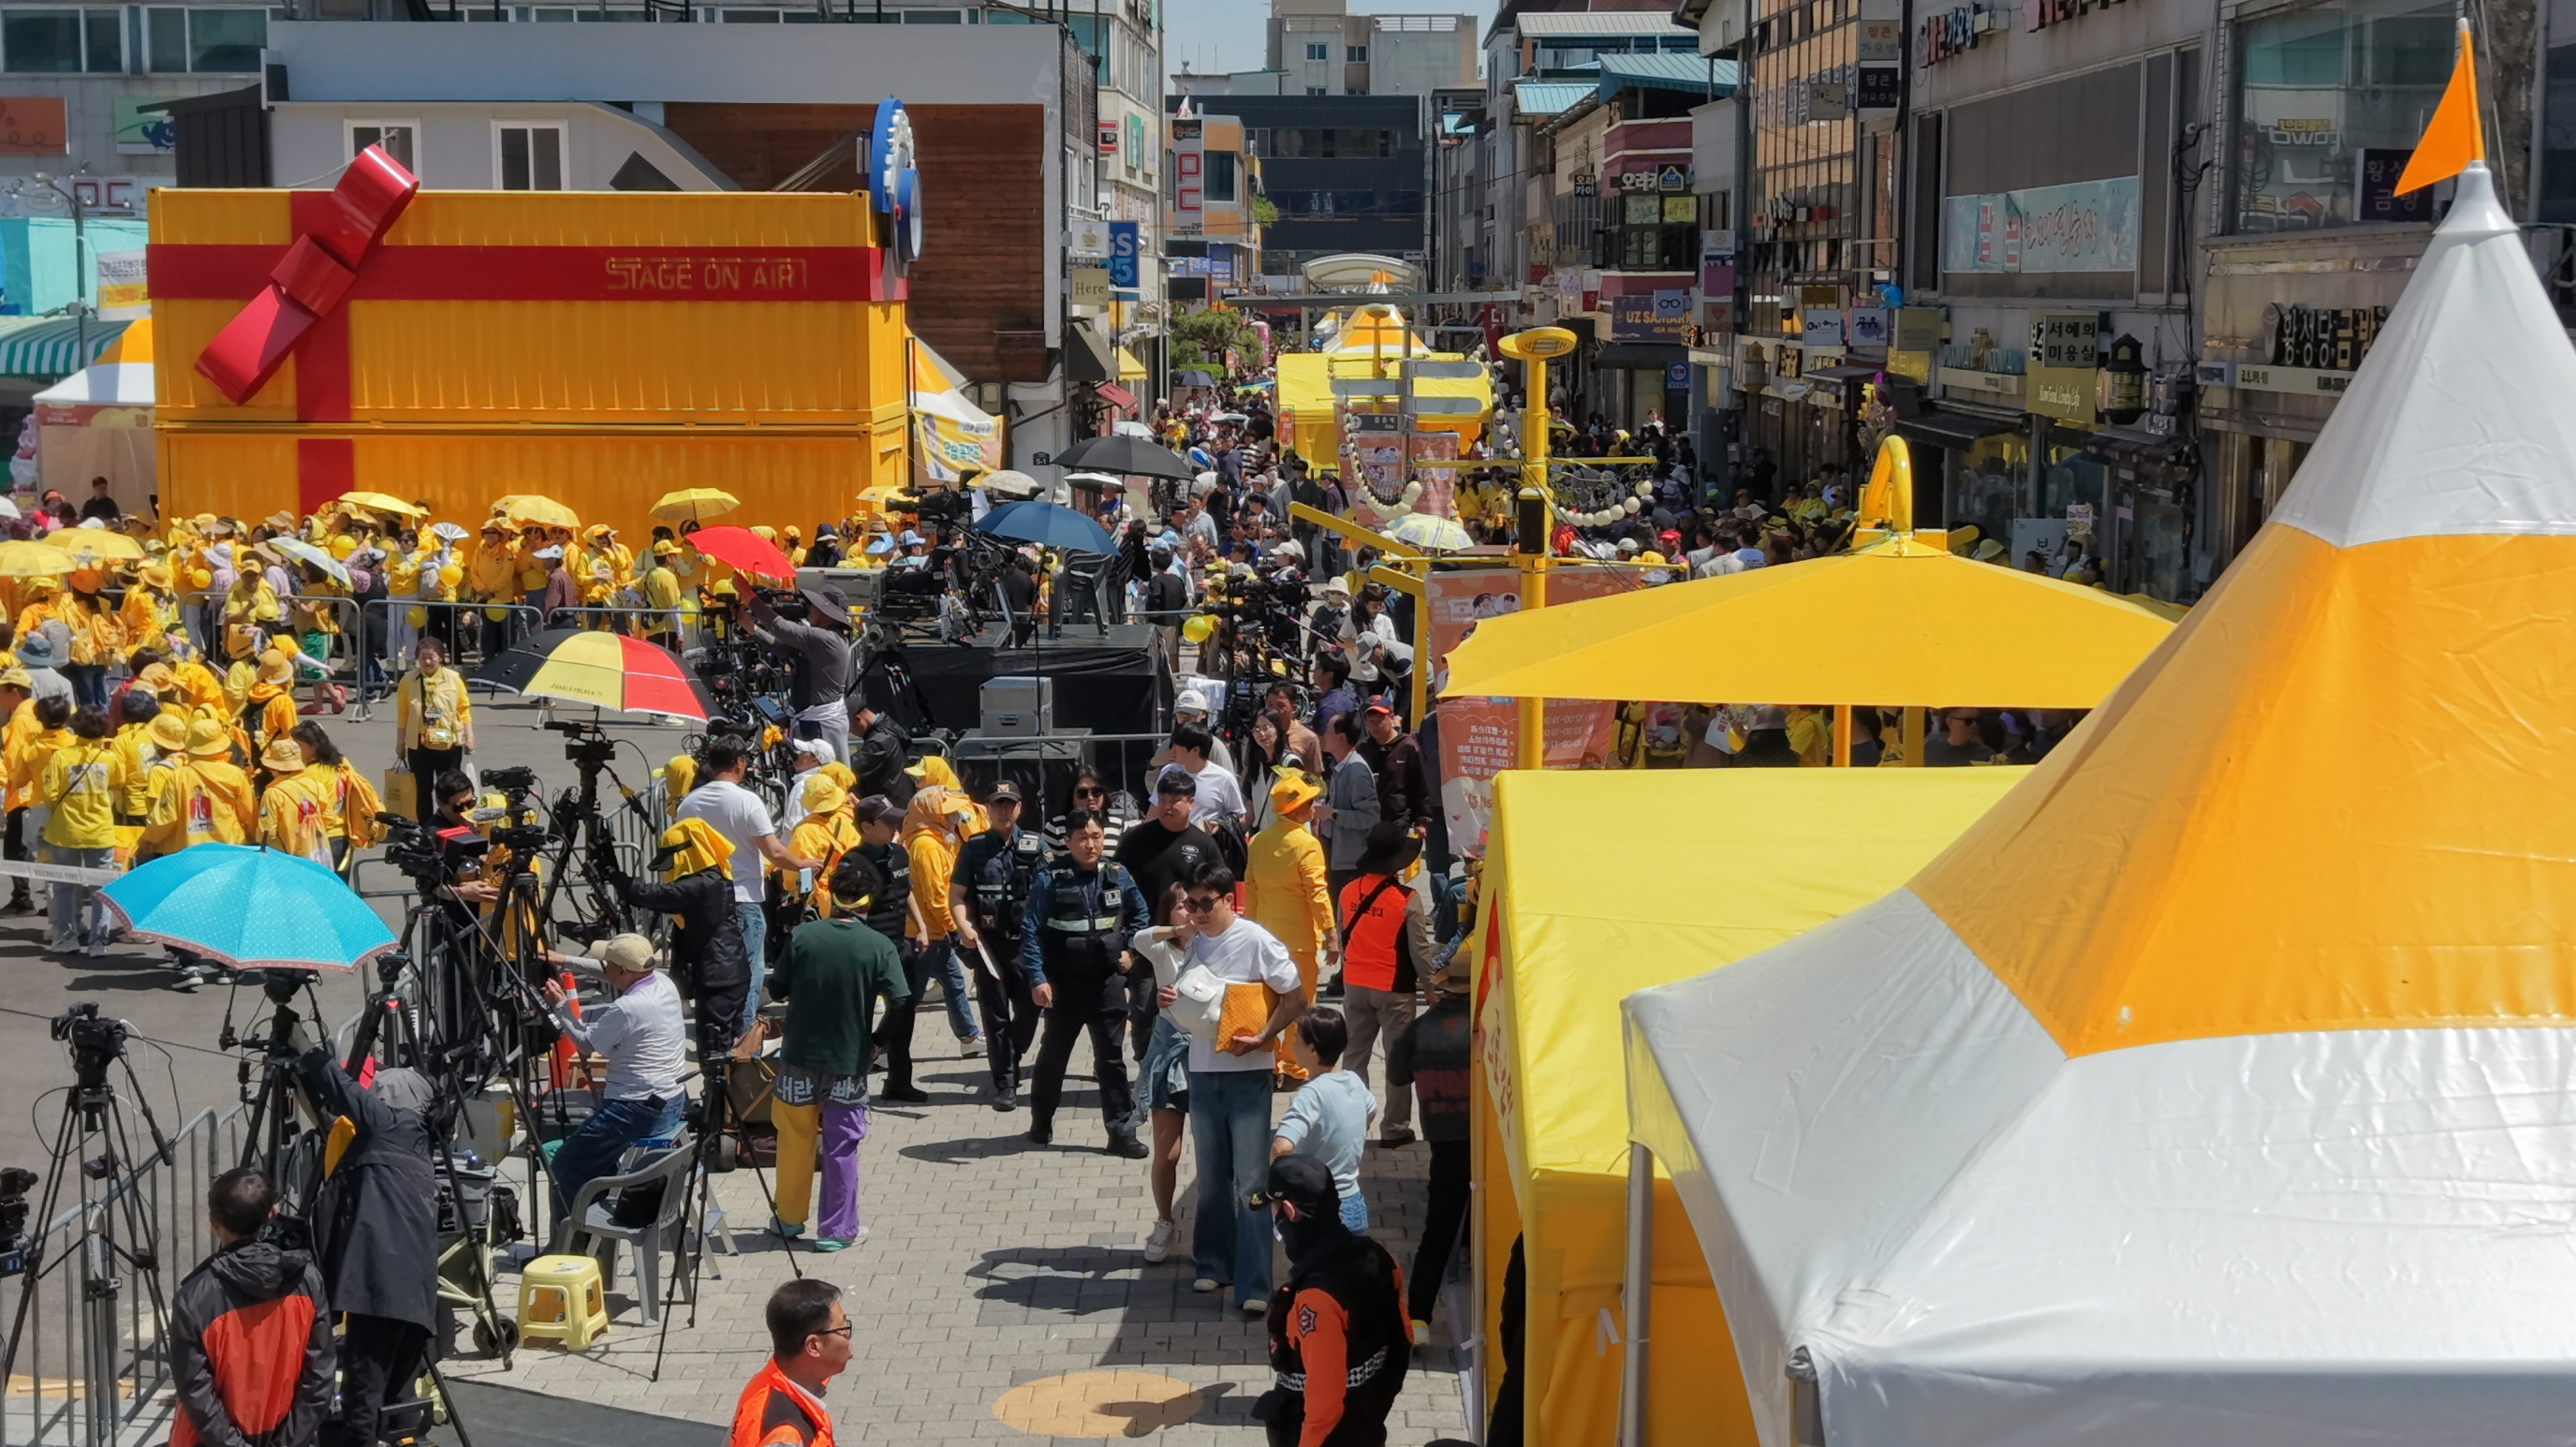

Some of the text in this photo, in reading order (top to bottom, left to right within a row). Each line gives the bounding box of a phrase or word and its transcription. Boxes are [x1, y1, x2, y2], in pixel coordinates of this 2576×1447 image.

[1177, 152, 1201, 212] PC
[606, 258, 794, 290] STAGE ON AIR
[1075, 282, 1105, 295] Here
[1626, 310, 1641, 323] UZ
[2048, 346, 2095, 362] 미용실
